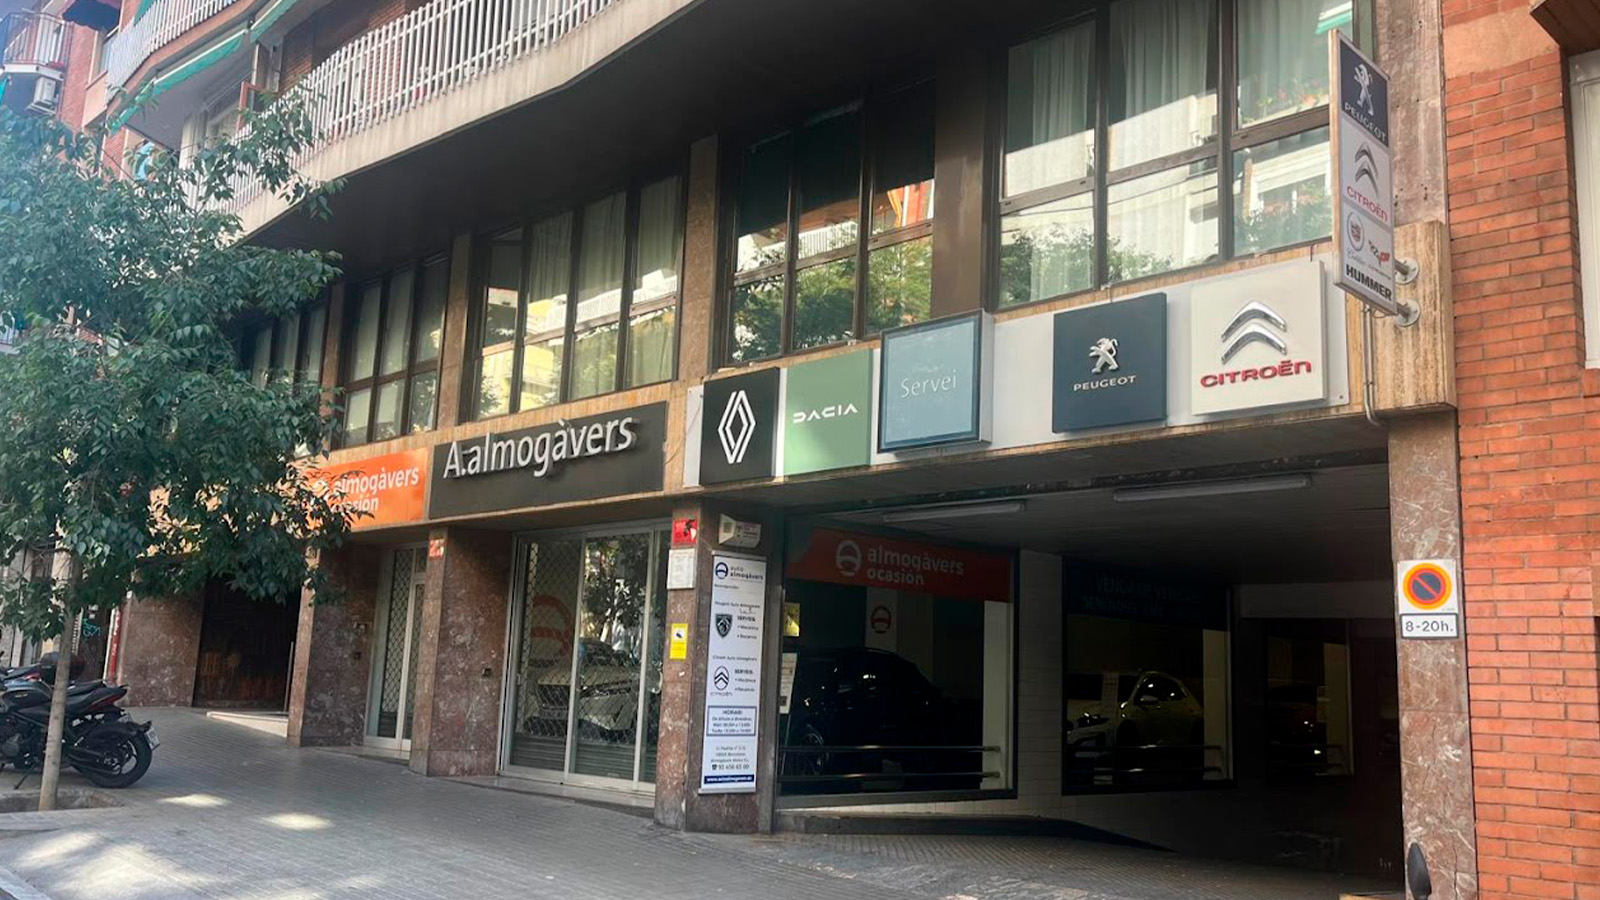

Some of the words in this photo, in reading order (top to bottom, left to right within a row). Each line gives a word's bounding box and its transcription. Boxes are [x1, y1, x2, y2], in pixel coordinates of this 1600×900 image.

[1344, 101, 1386, 142] PEUGEOT
[1346, 264, 1392, 301] HUMMER
[901, 370, 957, 399] Servei
[1073, 375, 1137, 392] PEUGEOT
[793, 403, 858, 424] DACIA
[443, 417, 635, 478] A.almogàvers
[868, 546, 964, 575] almogàvers
[867, 568, 924, 586] ocasión
[1405, 620, 1454, 633] 8-20h.
